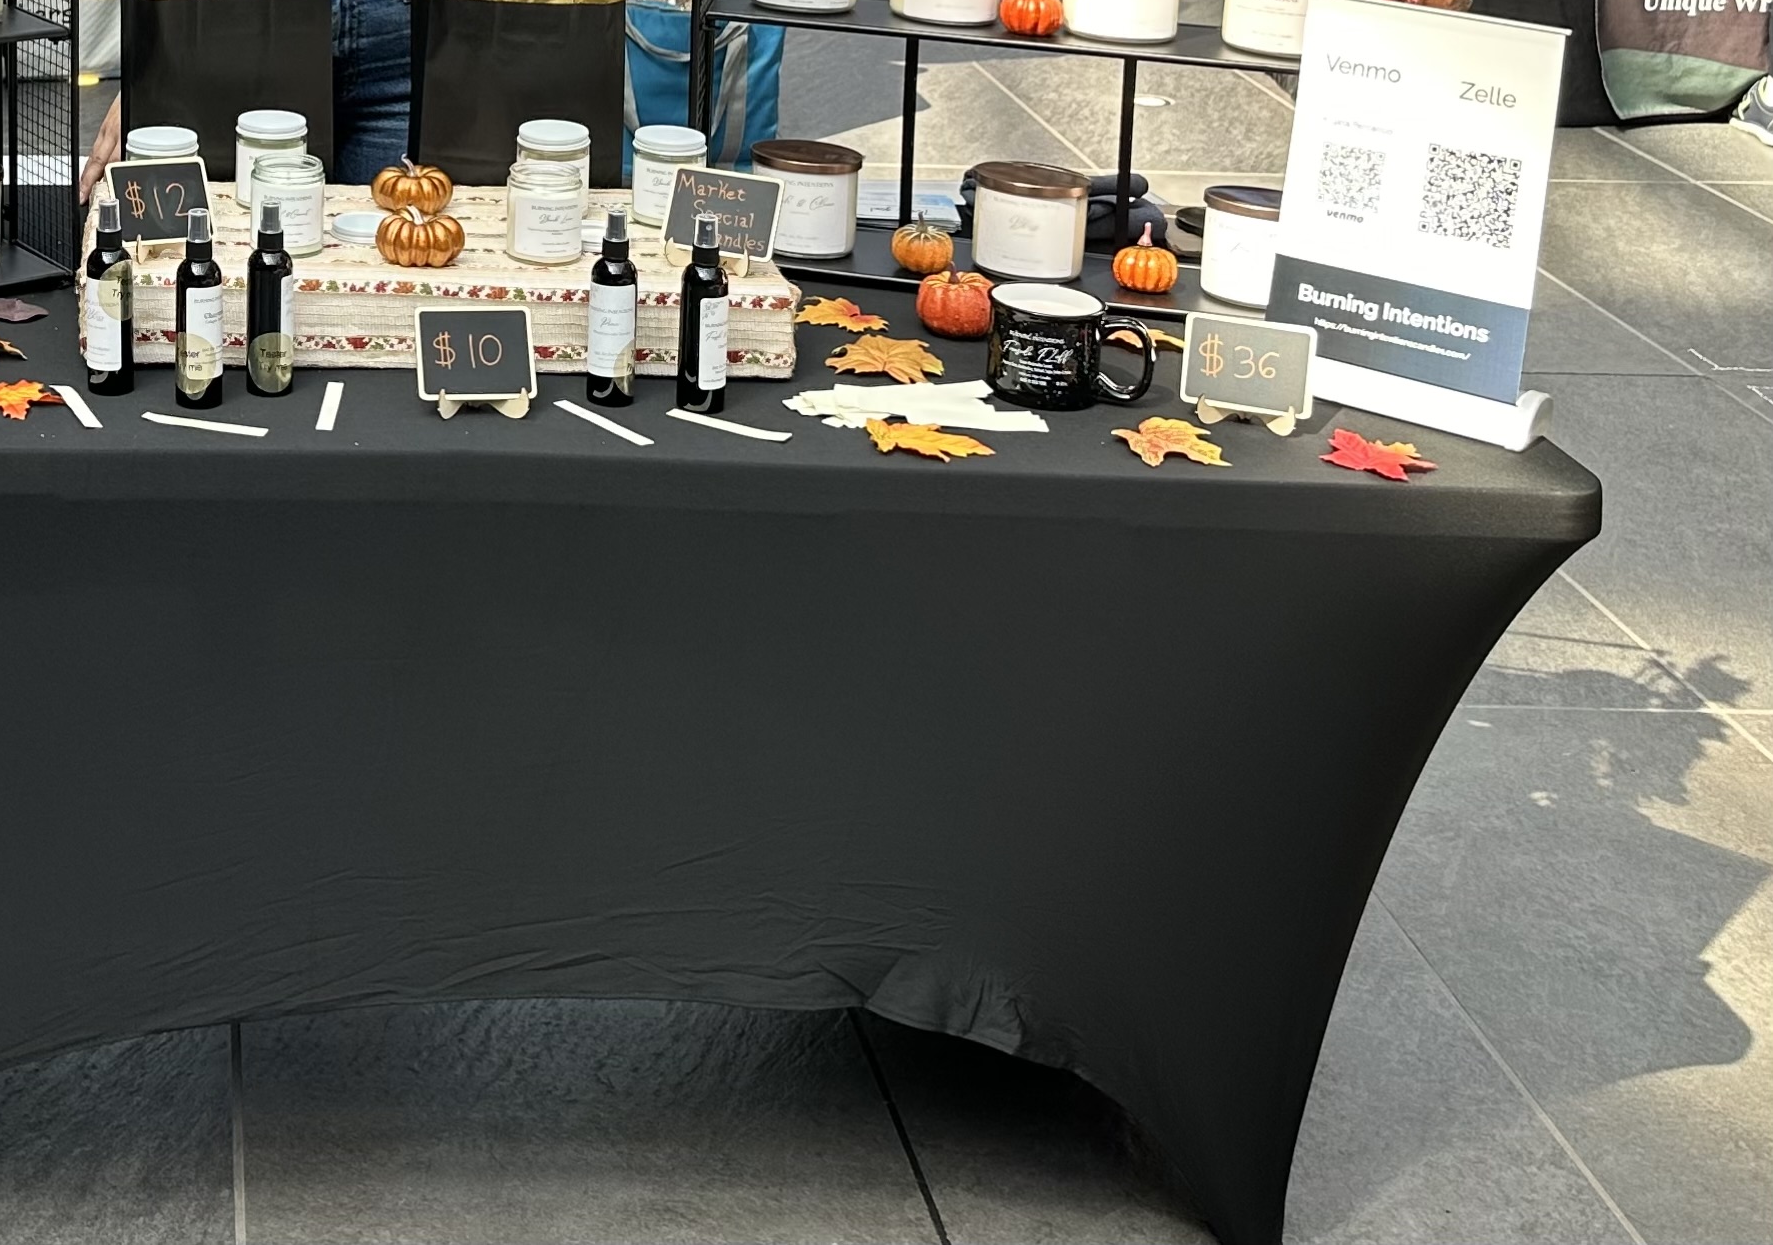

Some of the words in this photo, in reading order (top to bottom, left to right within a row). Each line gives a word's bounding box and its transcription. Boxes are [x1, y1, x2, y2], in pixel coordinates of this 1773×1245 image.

[1327, 53, 1402, 84] Venmo
[1459, 80, 1517, 109] Zelle
[124, 180, 191, 220] $12
[677, 172, 748, 202] Market
[1326, 209, 1364, 224] venmo
[716, 233, 766, 252] andles
[1297, 282, 1379, 322] Burning
[1382, 301, 1492, 343] Intentions
[433, 330, 503, 370] $10
[1198, 332, 1280, 379] $36
